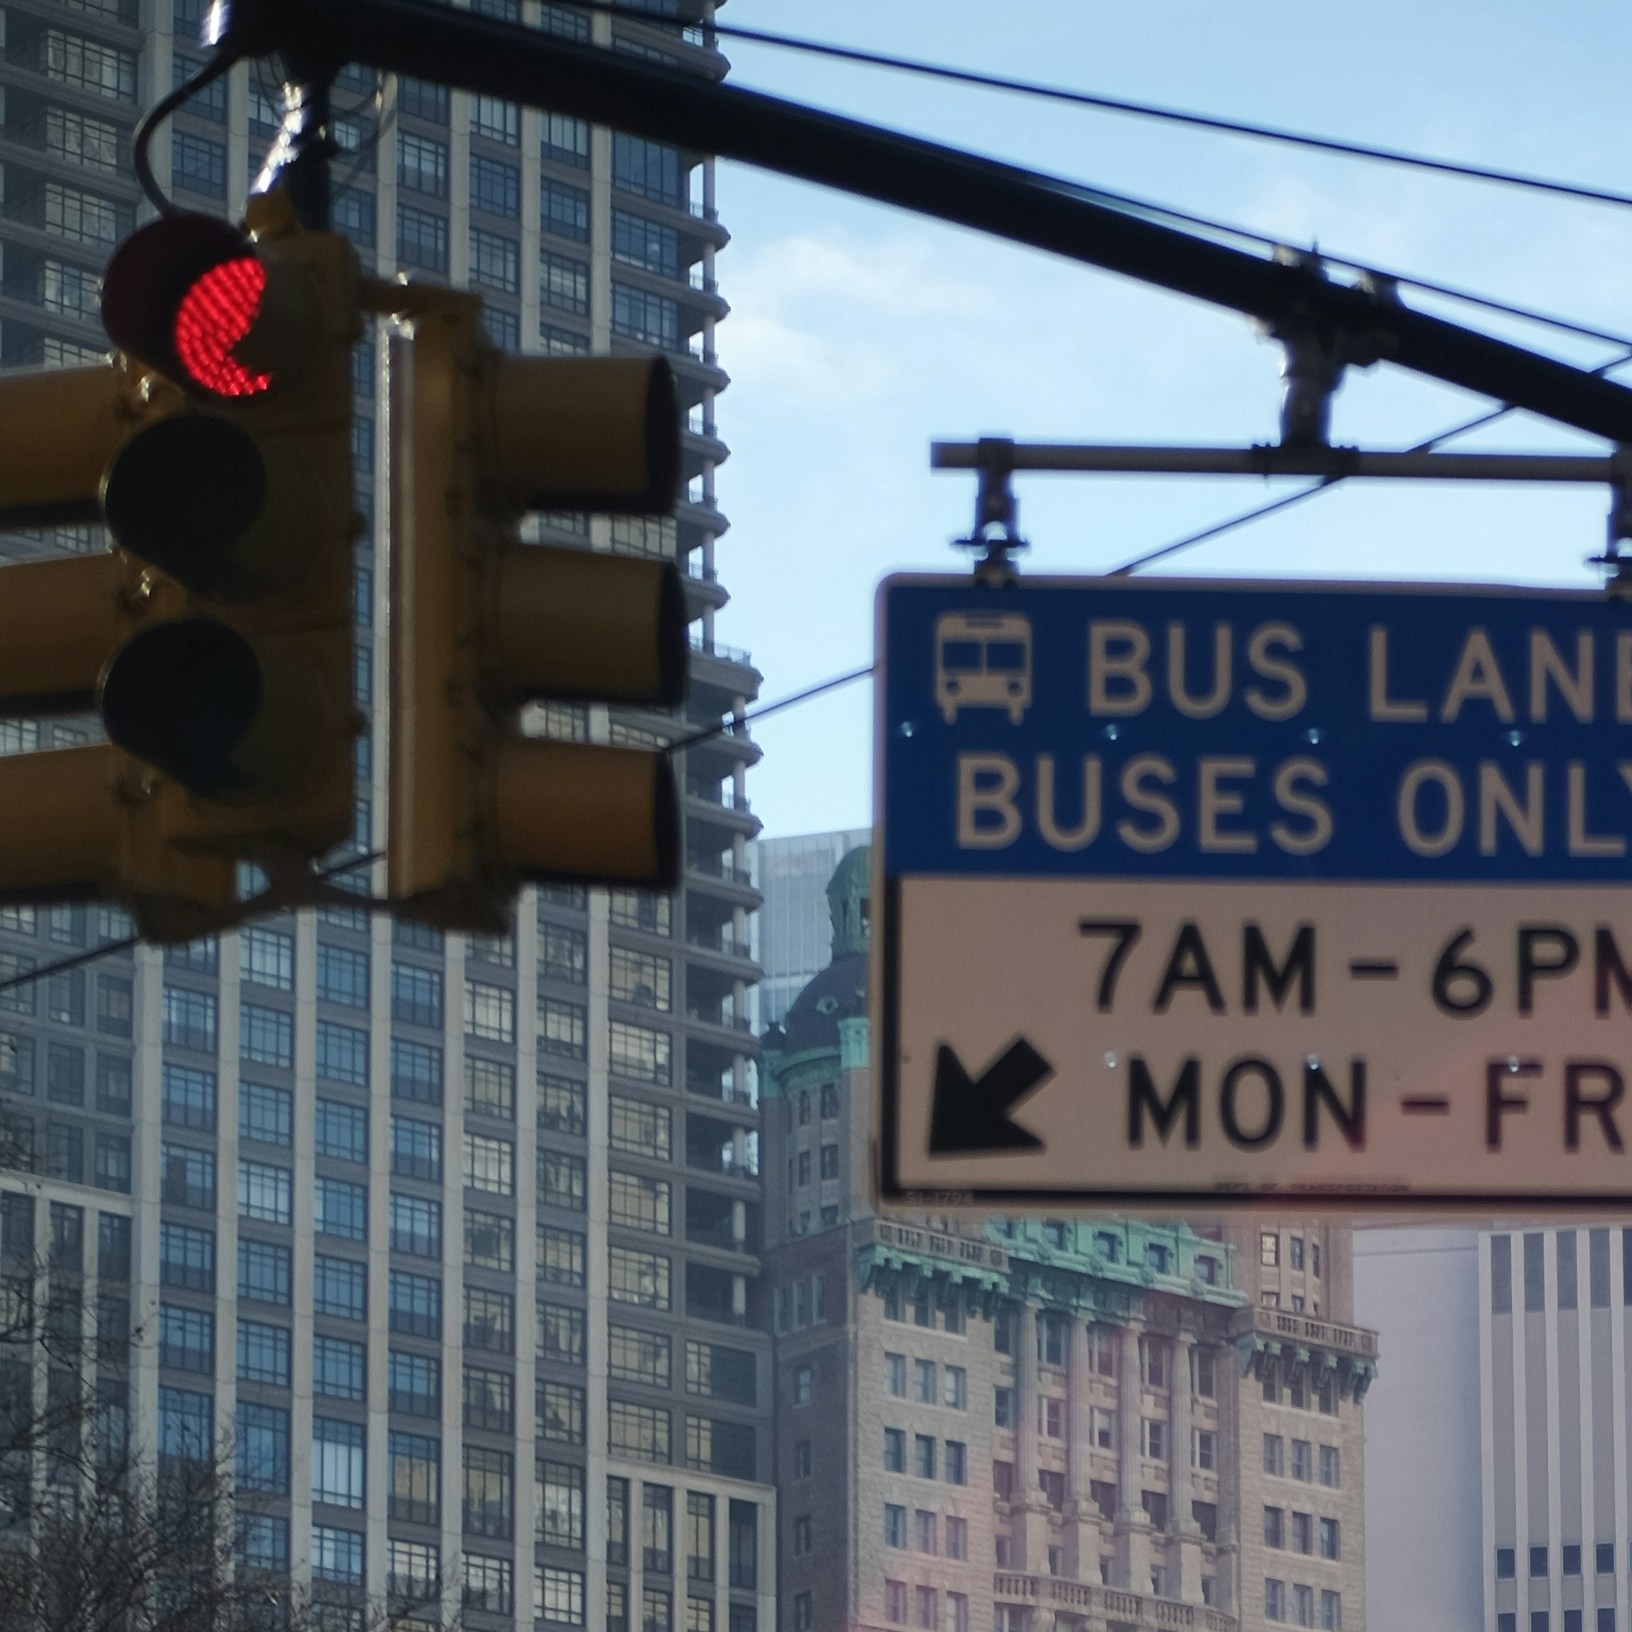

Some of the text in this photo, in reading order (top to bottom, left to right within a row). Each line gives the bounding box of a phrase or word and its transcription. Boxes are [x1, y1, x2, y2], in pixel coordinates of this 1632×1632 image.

[1090, 620, 1308, 721] BUS
[957, 755, 1334, 853] BUSES
[1215, 1182, 1411, 1193] DEPT OF TRANSPORTATION
